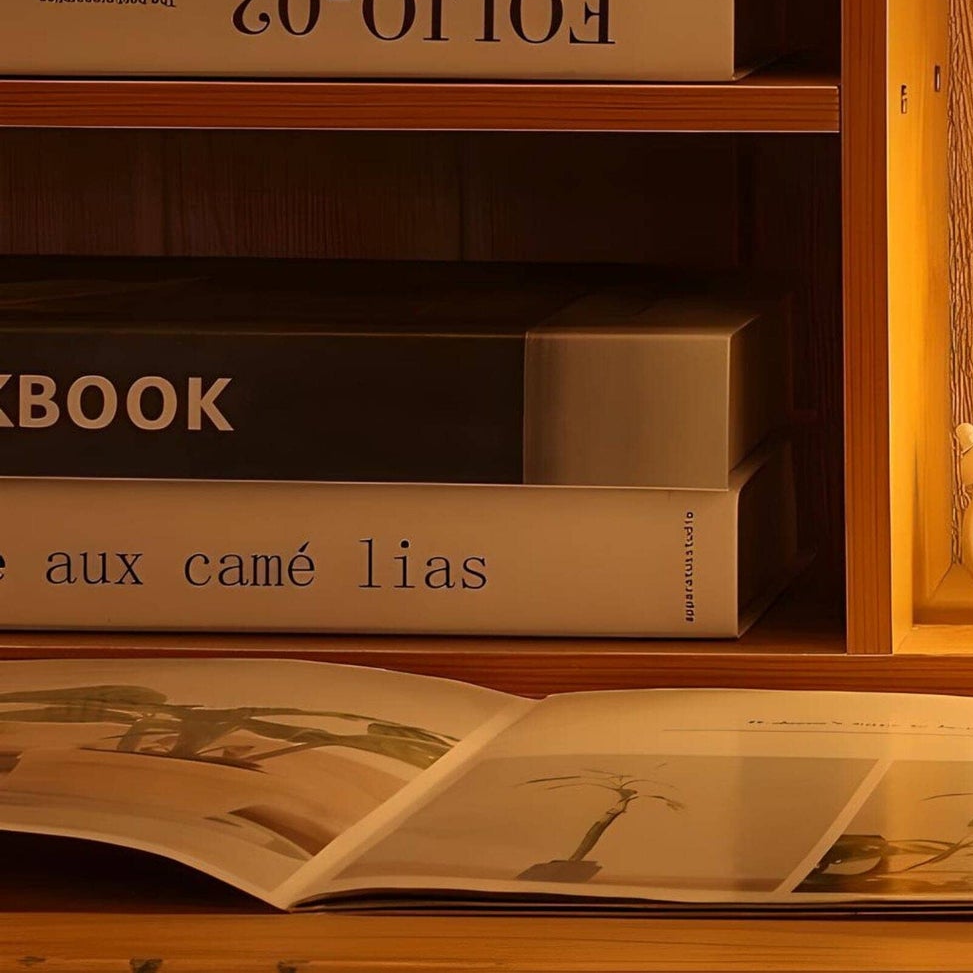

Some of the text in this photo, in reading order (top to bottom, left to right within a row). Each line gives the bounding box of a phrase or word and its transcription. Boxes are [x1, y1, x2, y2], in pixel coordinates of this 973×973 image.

[45, 551, 145, 586] aux
[184, 541, 316, 587] camé
[358, 539, 489, 590] lias
